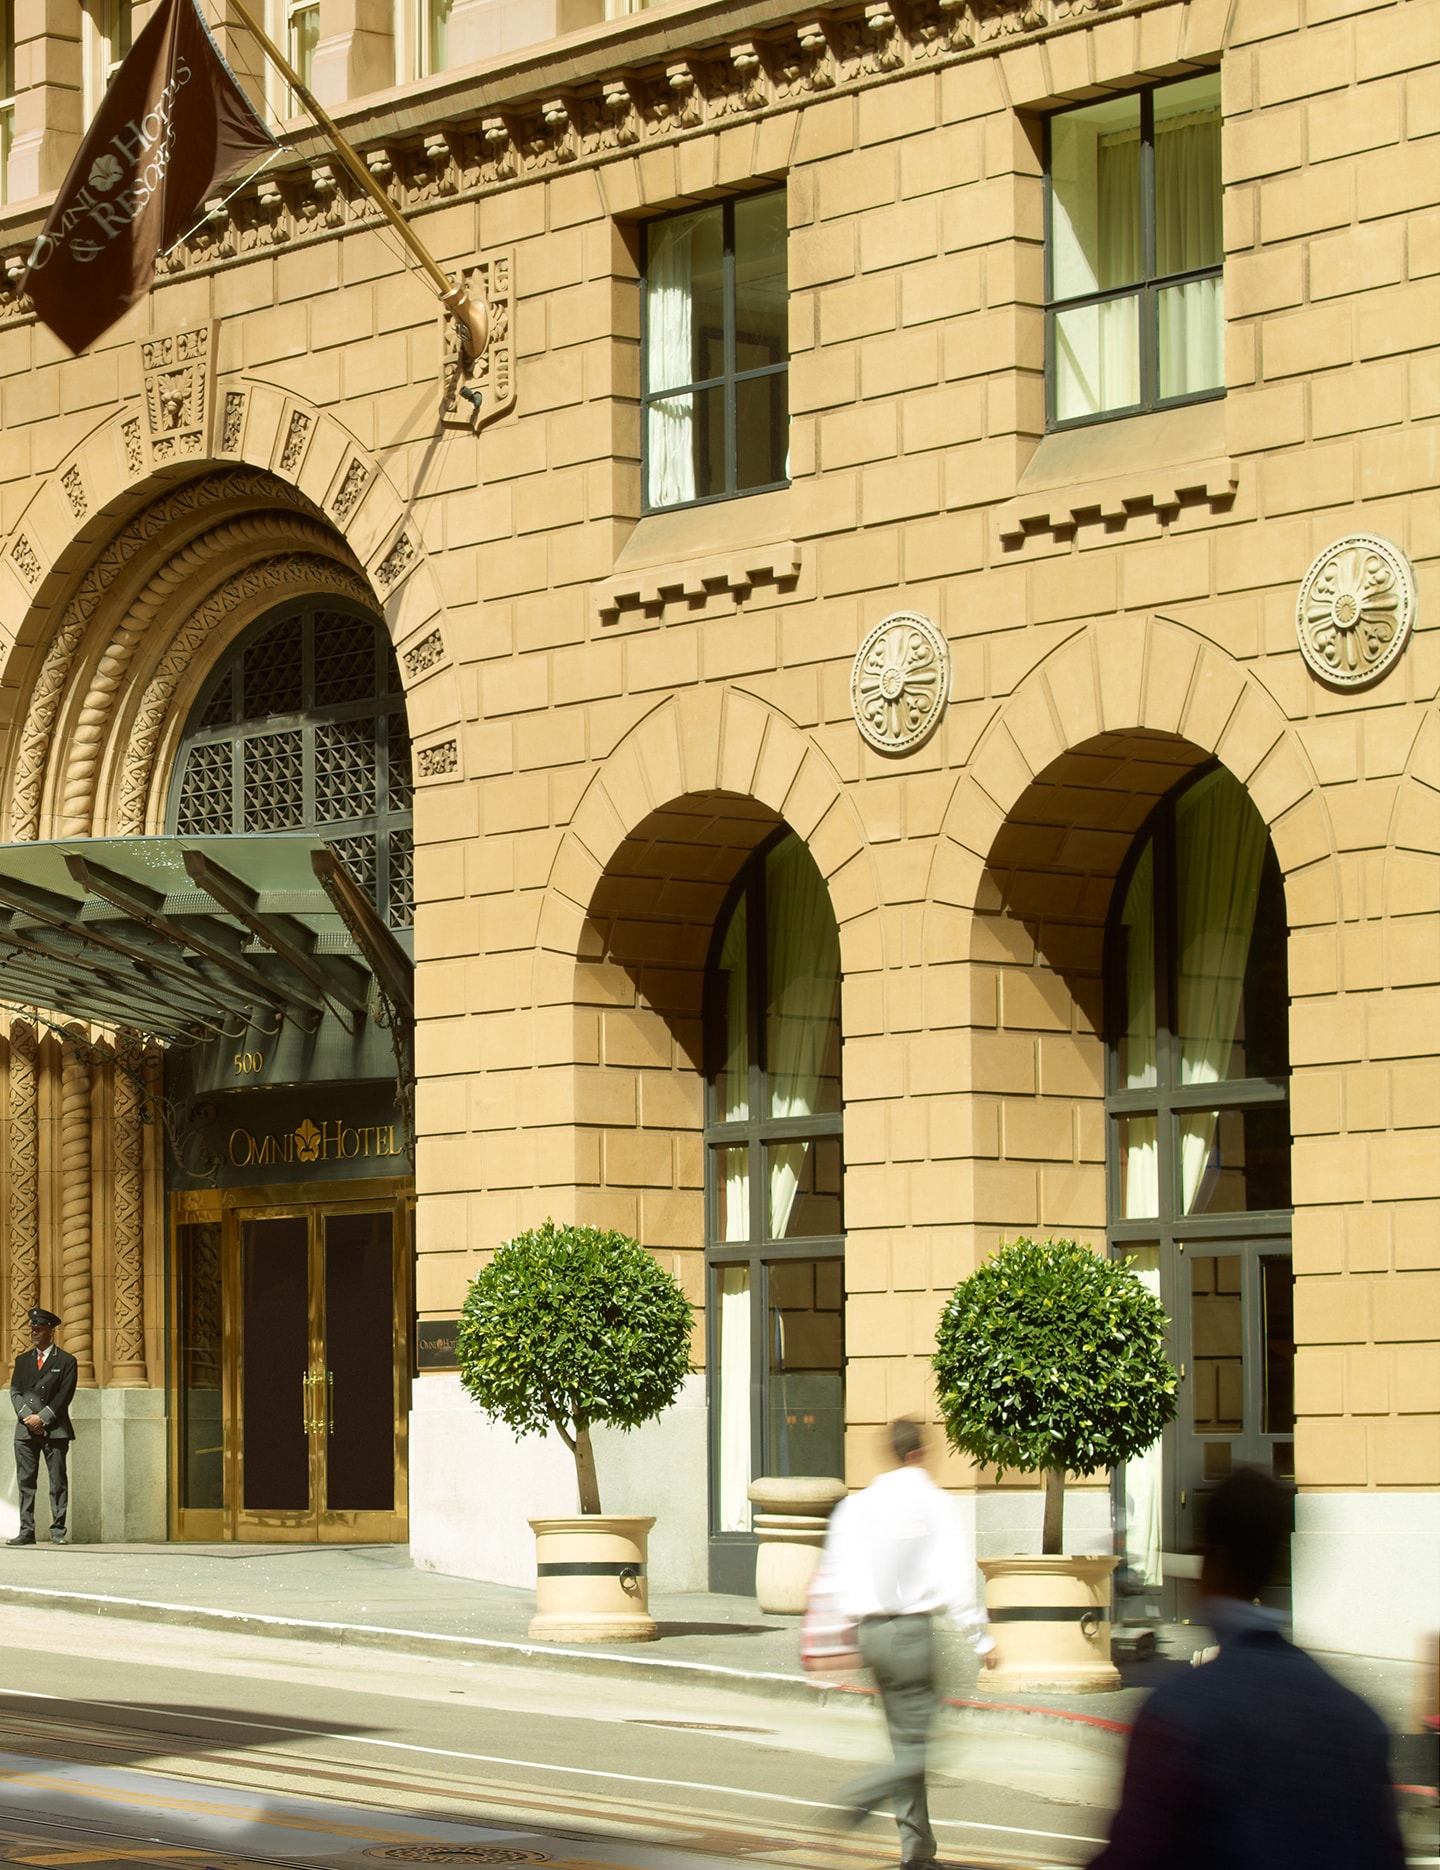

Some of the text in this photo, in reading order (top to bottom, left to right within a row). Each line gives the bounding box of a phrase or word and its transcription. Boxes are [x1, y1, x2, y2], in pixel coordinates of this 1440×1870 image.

[234, 1051, 264, 1076] 500
[228, 1120, 402, 1168] OMNI HOTEL
